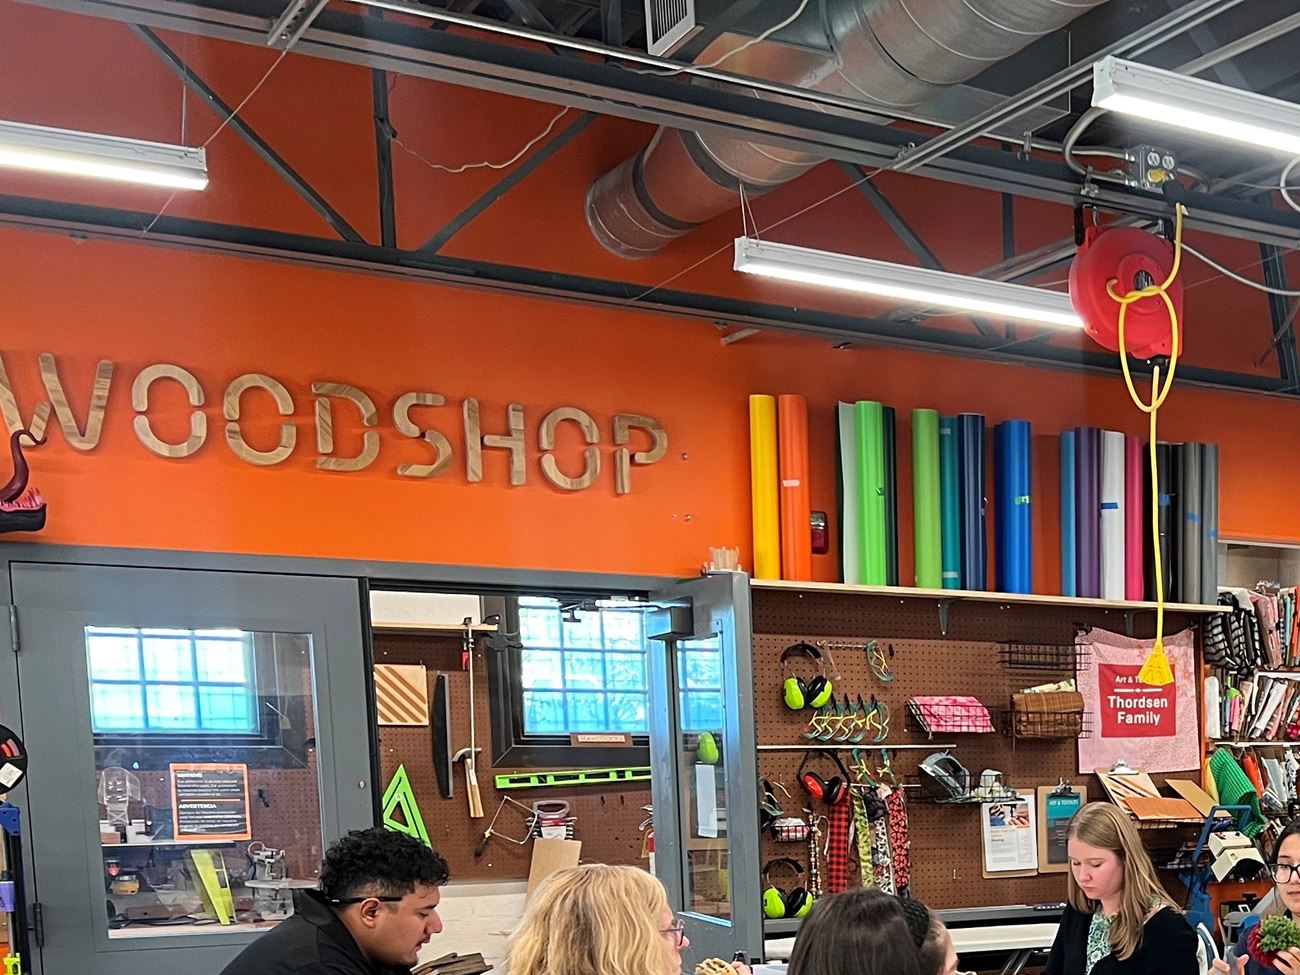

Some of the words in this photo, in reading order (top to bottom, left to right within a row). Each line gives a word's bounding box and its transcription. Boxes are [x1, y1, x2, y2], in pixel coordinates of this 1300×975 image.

[0, 352, 668, 495] WOODSHOP
[1115, 675, 1127, 684] Art
[1107, 695, 1169, 709] Thordsen
[1117, 711, 1161, 726] Family
